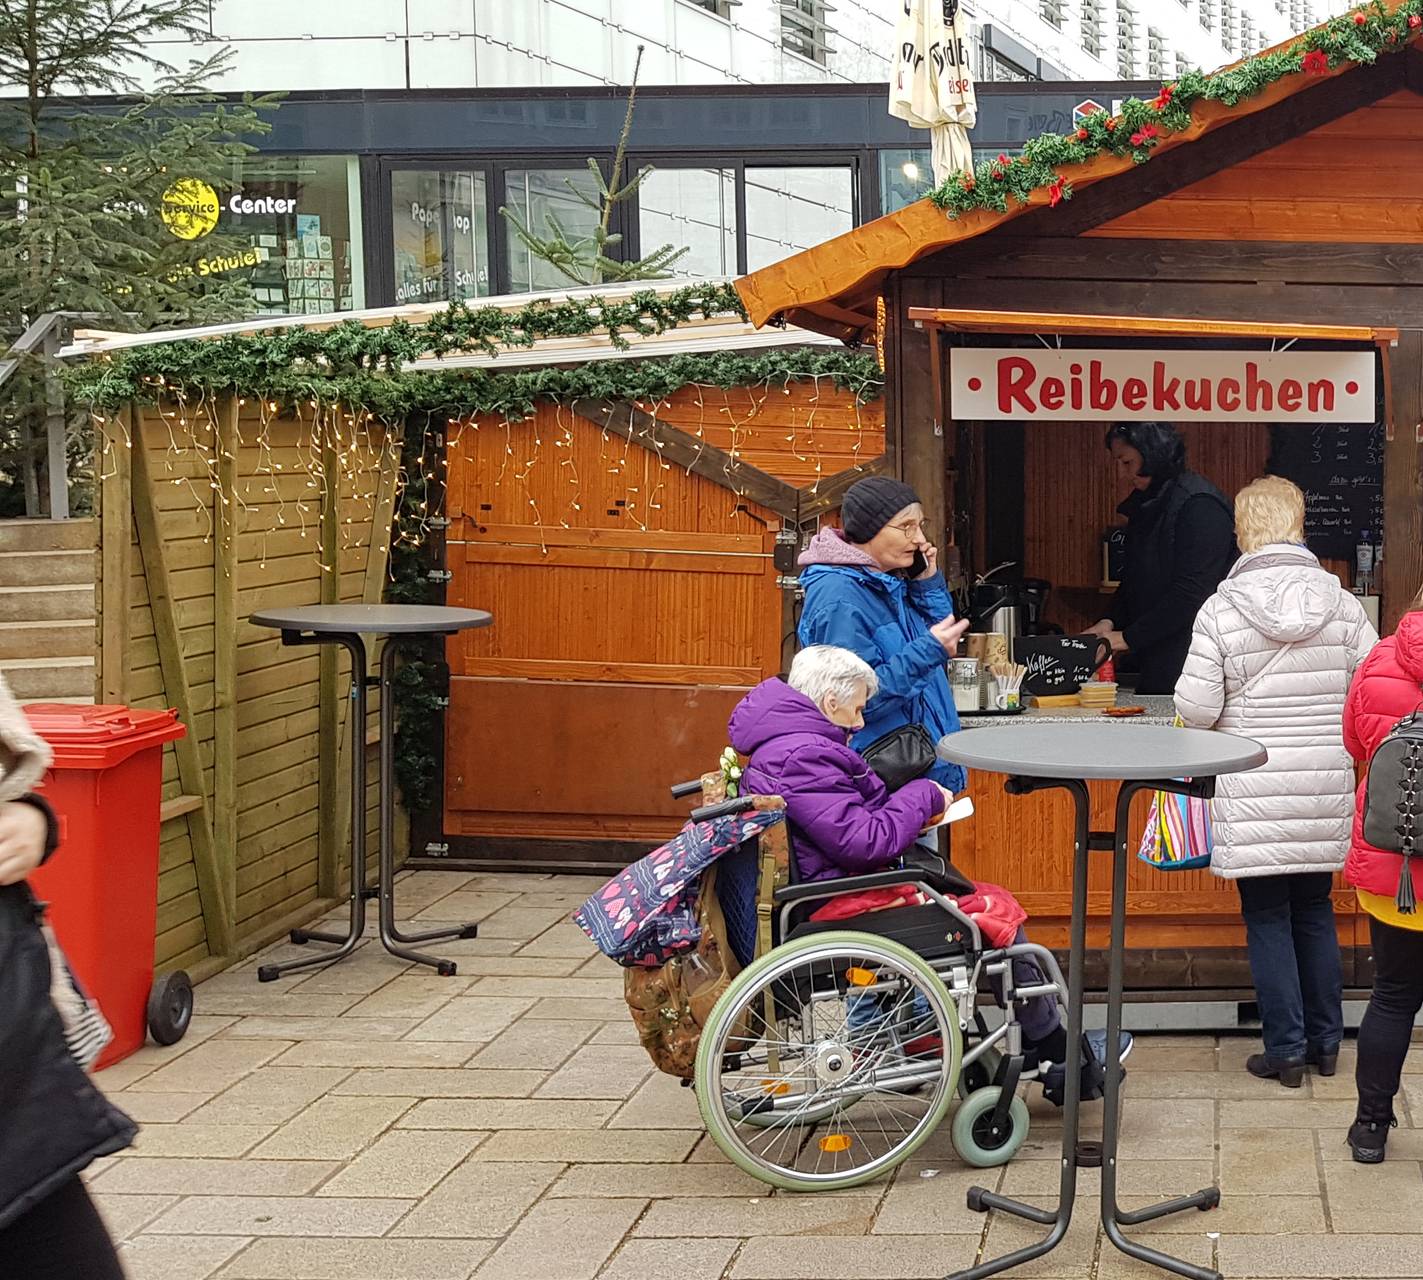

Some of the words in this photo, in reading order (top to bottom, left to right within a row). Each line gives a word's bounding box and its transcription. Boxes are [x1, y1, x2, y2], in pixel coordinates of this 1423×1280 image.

[229, 194, 297, 214] Center
[997, 356, 1335, 414] Reibekuchen
[1026, 652, 1054, 675] Kaffee
